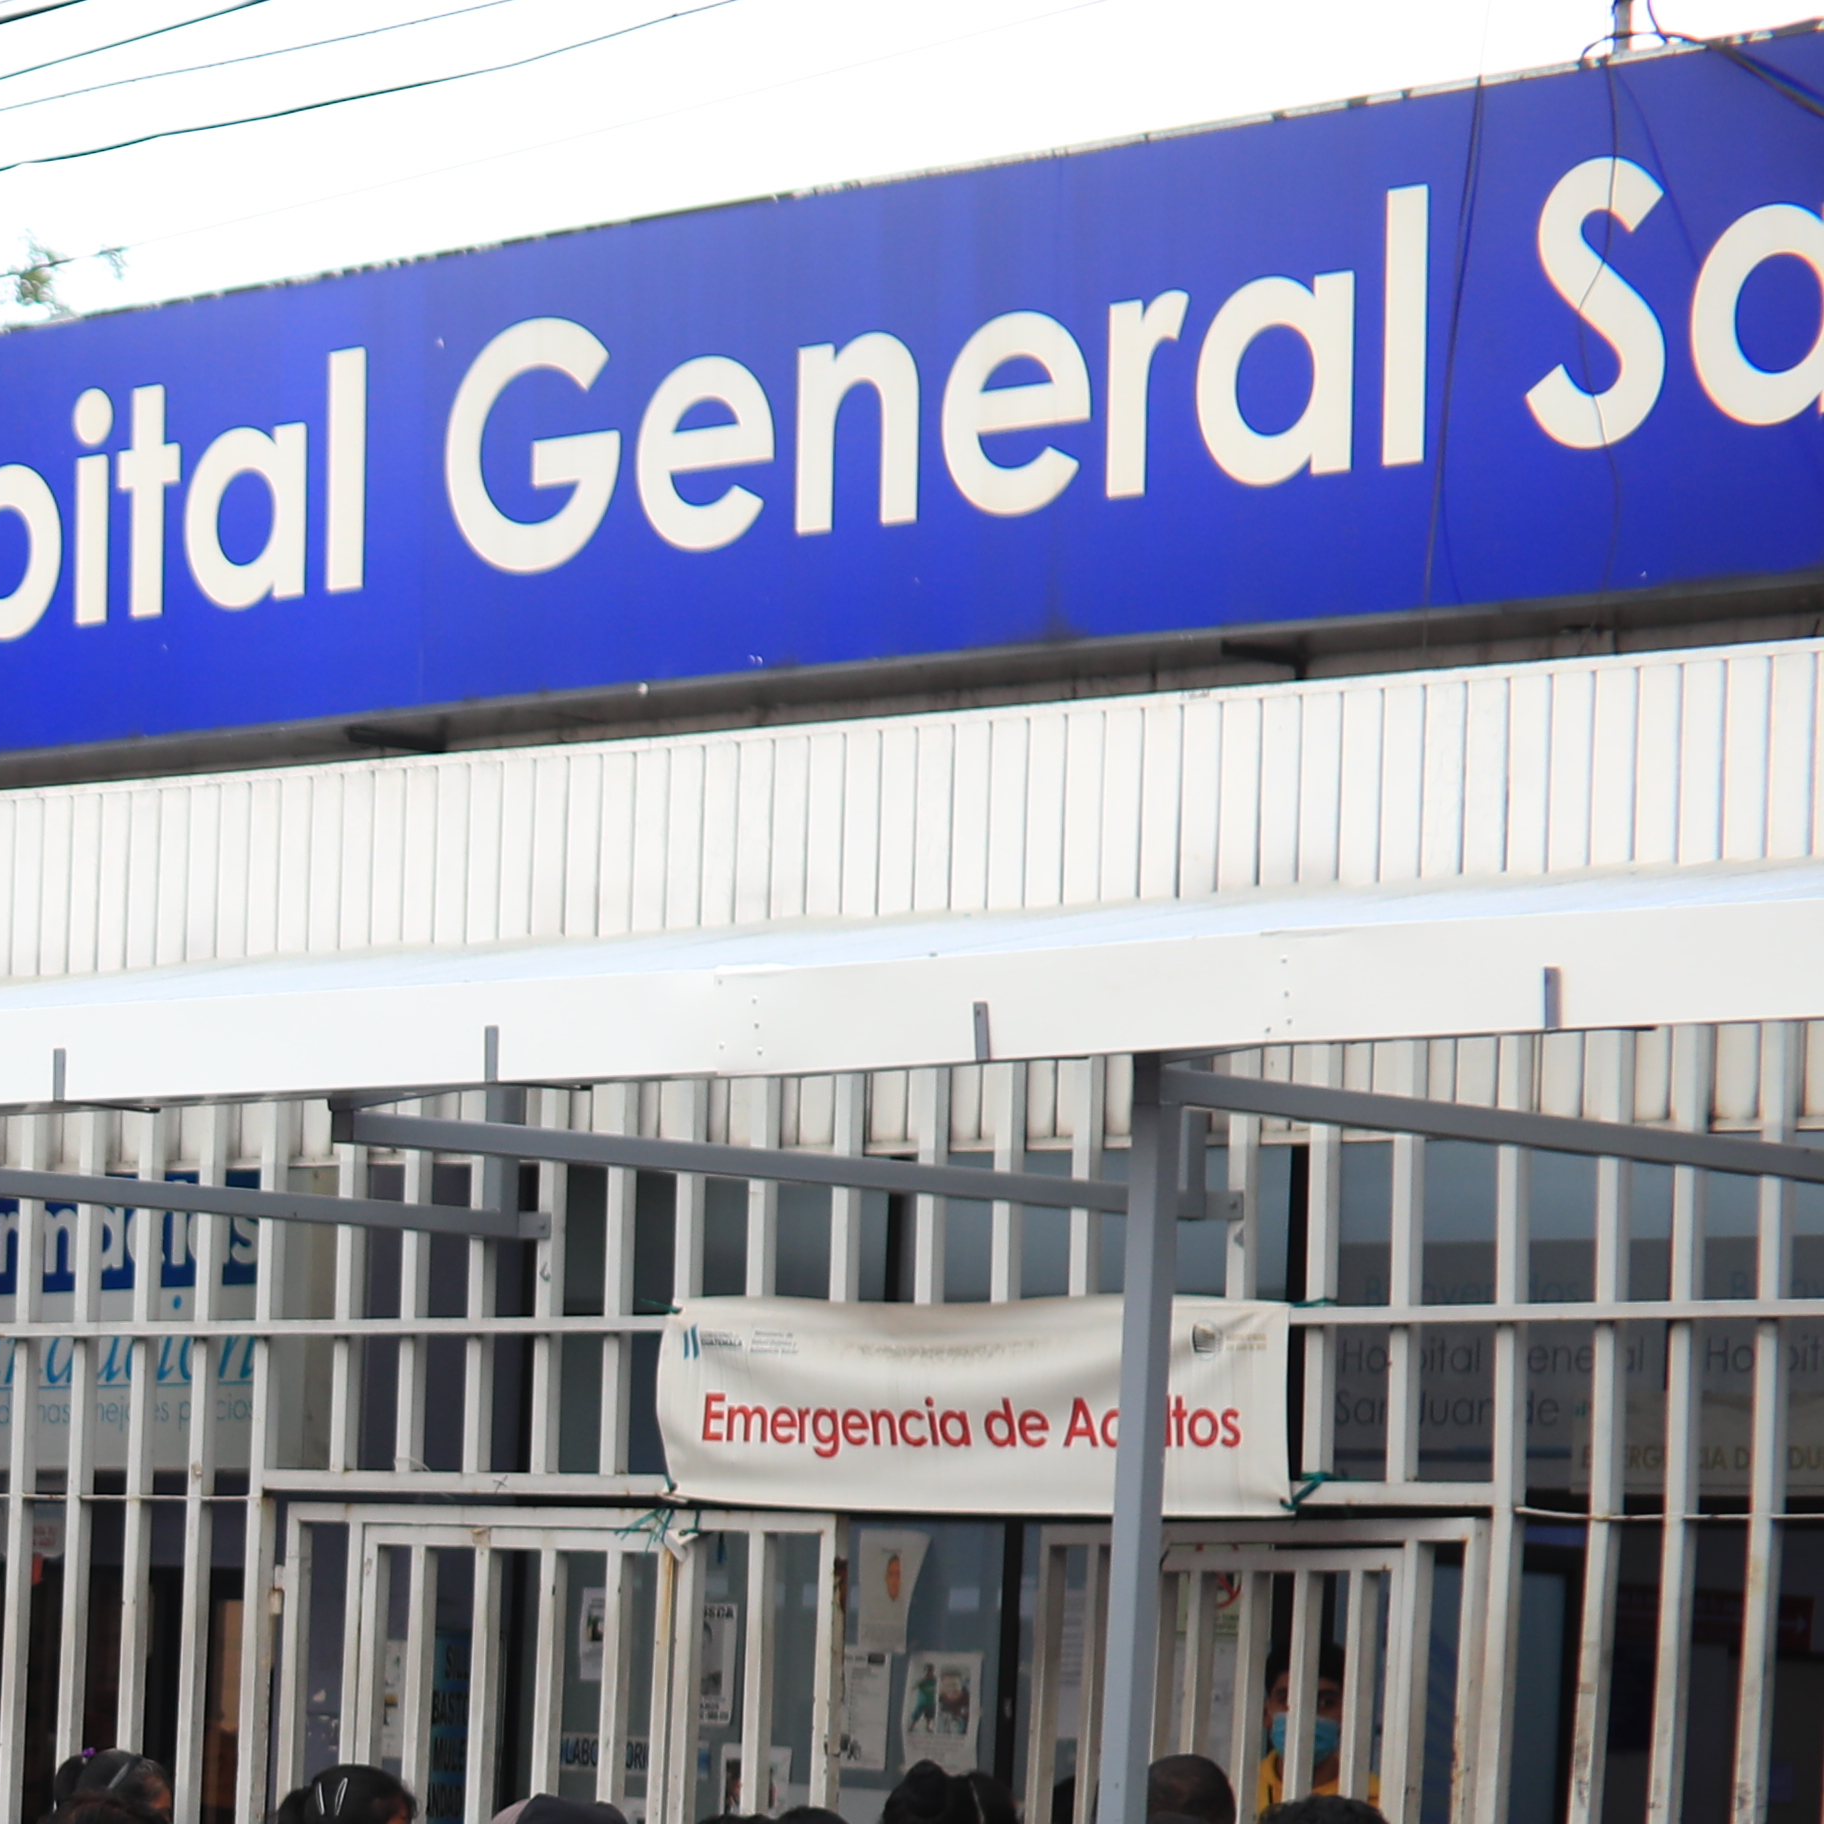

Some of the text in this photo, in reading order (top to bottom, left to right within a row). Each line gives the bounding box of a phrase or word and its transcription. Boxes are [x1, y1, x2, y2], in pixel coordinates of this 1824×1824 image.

[445, 186, 1427, 573] General
[702, 1392, 1242, 1458] Emergencia de Altos
